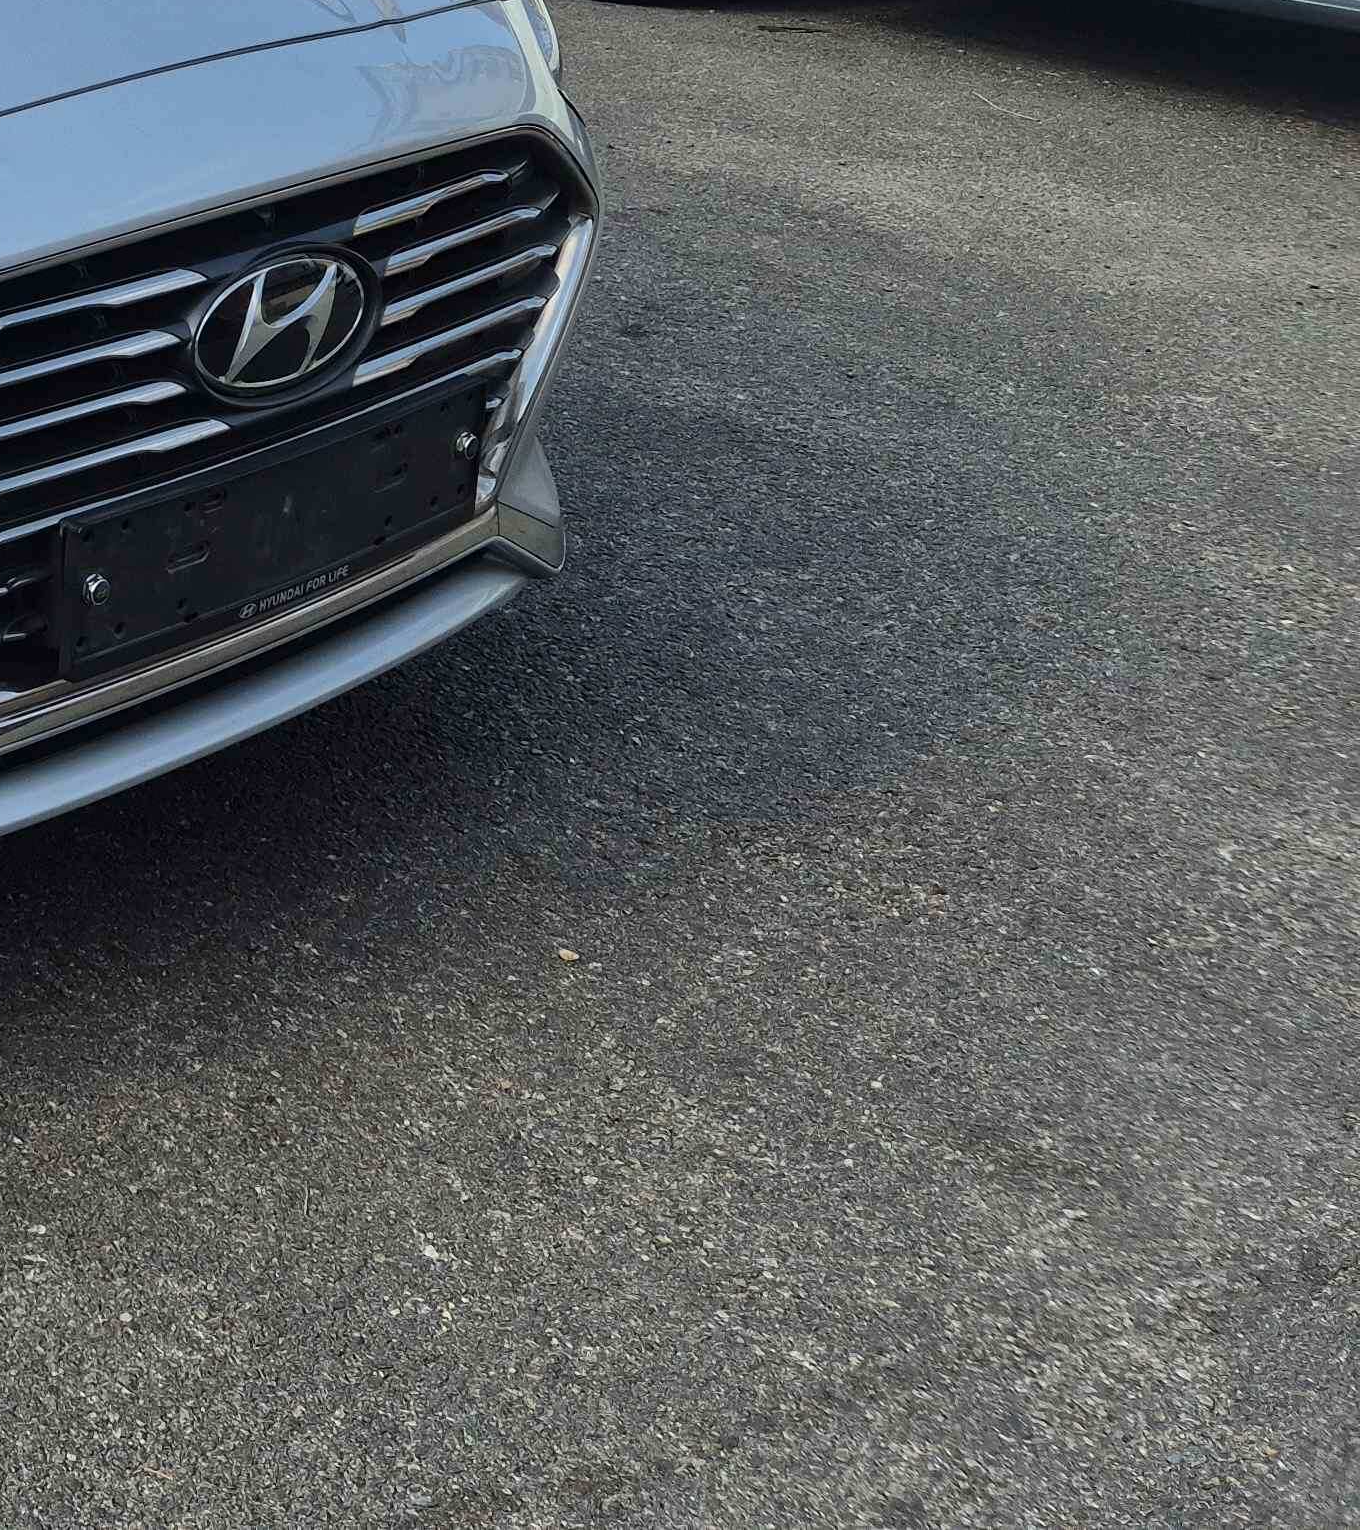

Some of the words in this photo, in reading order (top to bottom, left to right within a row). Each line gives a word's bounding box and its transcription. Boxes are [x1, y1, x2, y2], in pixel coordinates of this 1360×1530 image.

[259, 583, 305, 611] HYUNDAI
[305, 575, 327, 592] FOR
[328, 565, 350, 582] LIFE
